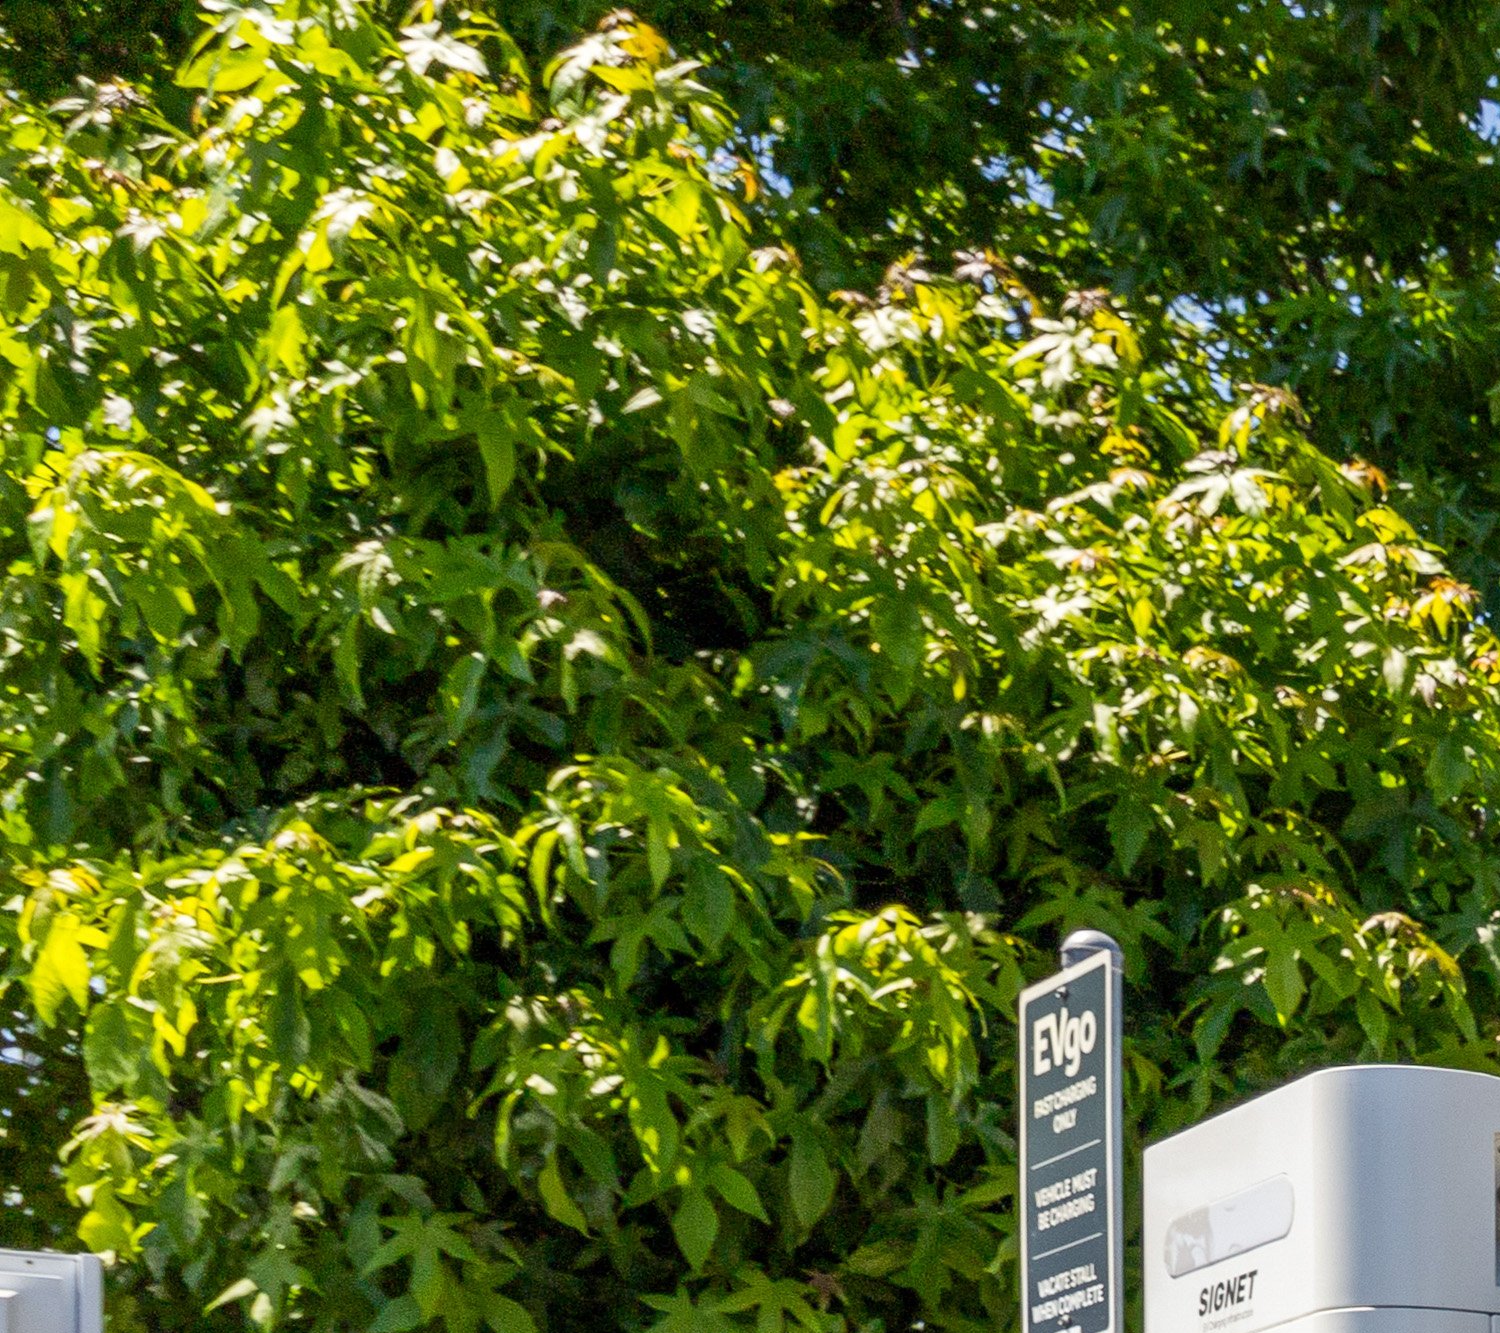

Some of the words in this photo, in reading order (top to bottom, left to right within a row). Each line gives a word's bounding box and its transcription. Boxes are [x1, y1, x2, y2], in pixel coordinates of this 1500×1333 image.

[1034, 1007, 1096, 1077] EVgo
[1035, 1178, 1071, 1208] VEHICLE
[1072, 1168, 1097, 1193] MUST
[1038, 1210, 1050, 1230] BE
[1051, 1193, 1095, 1227] CHARGING
[1038, 1271, 1071, 1298] VACATE
[1071, 1263, 1097, 1287] STALL
[1199, 1270, 1257, 1316] SIGNET
[1032, 1300, 1057, 1324] WHEN
[1059, 1284, 1104, 1316] COMPLETE
